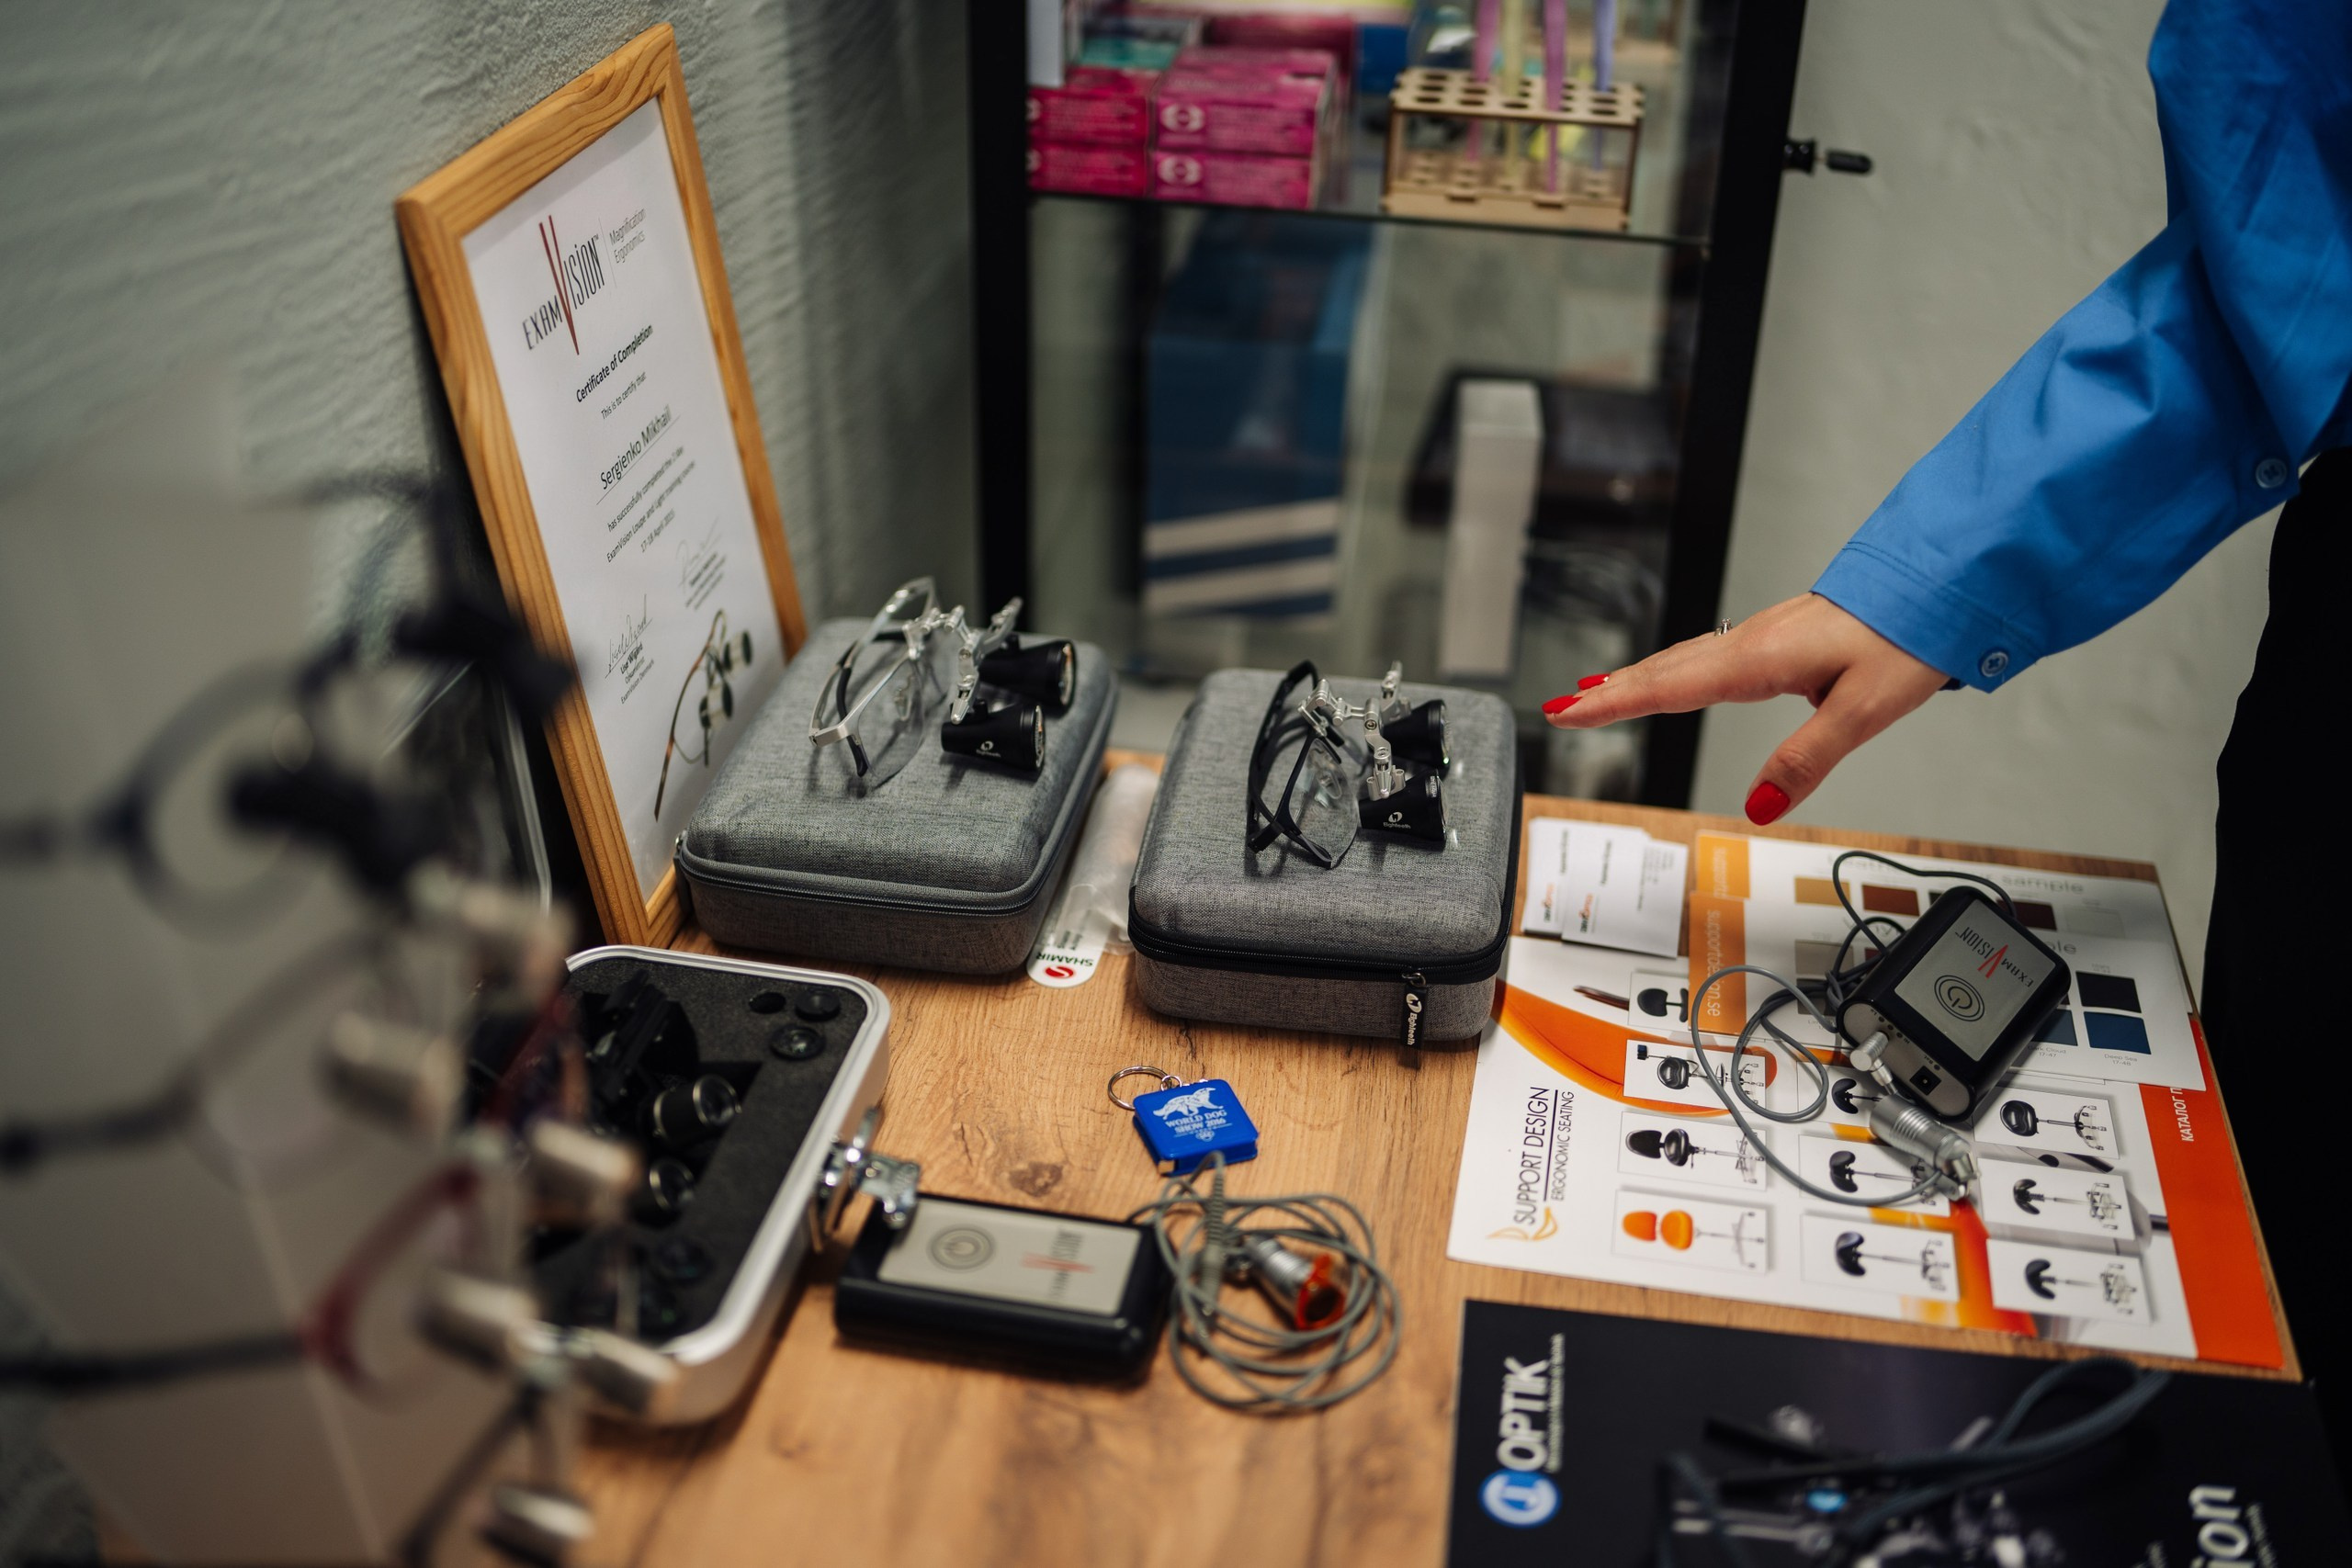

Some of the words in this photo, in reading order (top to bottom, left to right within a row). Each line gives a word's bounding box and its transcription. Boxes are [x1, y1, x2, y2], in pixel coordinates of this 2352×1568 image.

[576, 366, 610, 402] Certificate
[610, 354, 618, 371] of
[617, 325, 653, 363] Completion
[601, 405, 613, 420] This
[621, 381, 638, 400] certify
[600, 440, 642, 490] Sergienko
[641, 404, 672, 446] Mikhail
[607, 519, 617, 533] has
[606, 530, 633, 563] ExamVision
[1036, 952, 1093, 966] SHAMIR
[2046, 1046, 2066, 1055] Cloud
[2104, 1054, 2122, 1062] Deep
[1165, 1114, 1204, 1128] WORLD
[1204, 1109, 1227, 1121] DOG
[1174, 1121, 1204, 1134] SHOW
[1204, 1117, 1227, 1128] 2016
[1523, 1086, 1550, 1148] DESIGN
[1557, 1090, 1575, 1133] SEATING
[2172, 1095, 2194, 1142] КАТАЛОГ
[1551, 1134, 1570, 1201] ERGONOMIC
[1513, 1151, 1543, 1226] SUPPORT
